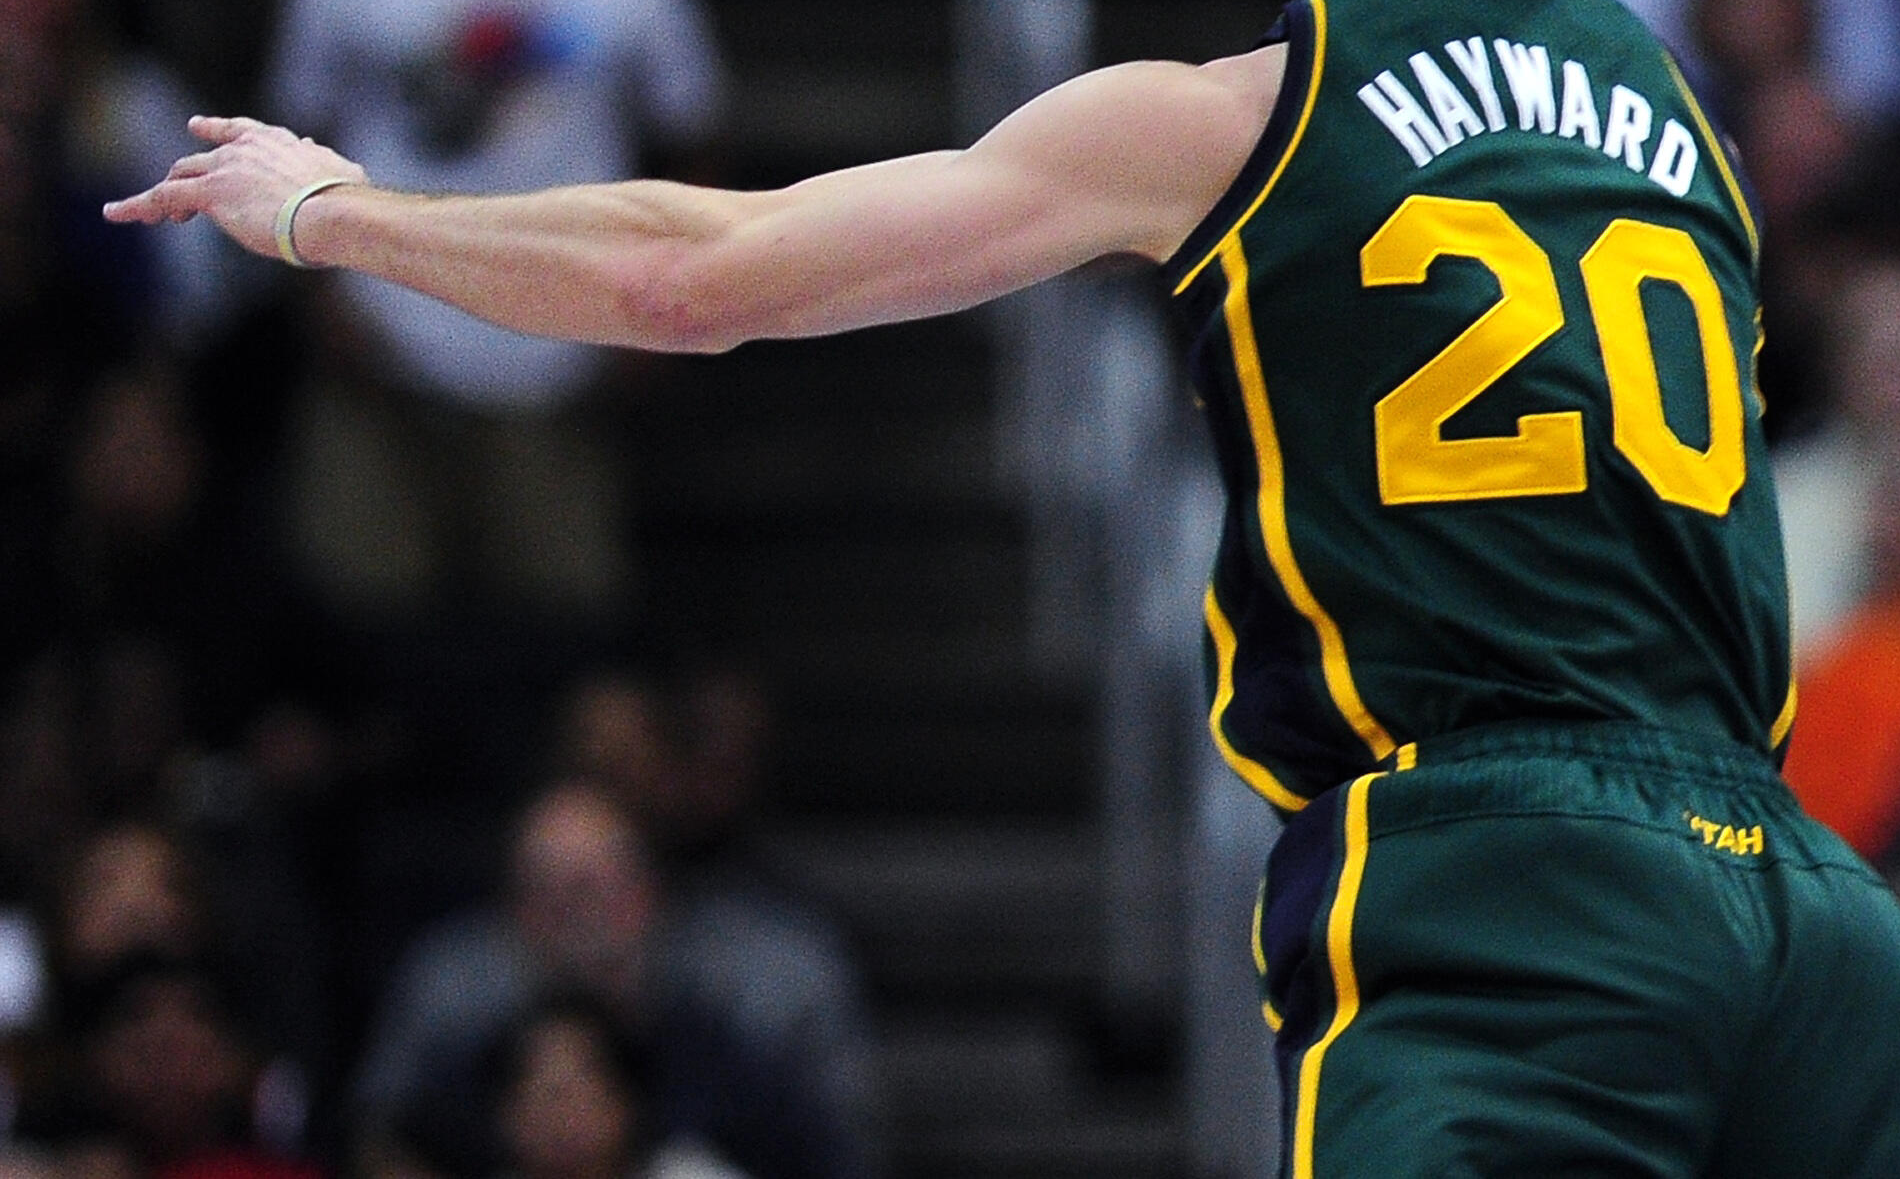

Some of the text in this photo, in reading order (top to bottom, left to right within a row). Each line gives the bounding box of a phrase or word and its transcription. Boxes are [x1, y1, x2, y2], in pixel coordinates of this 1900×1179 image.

[1357, 35, 1699, 198] HAYWARD
[1360, 194, 1745, 517] 20
[1684, 811, 1764, 855] TAH
